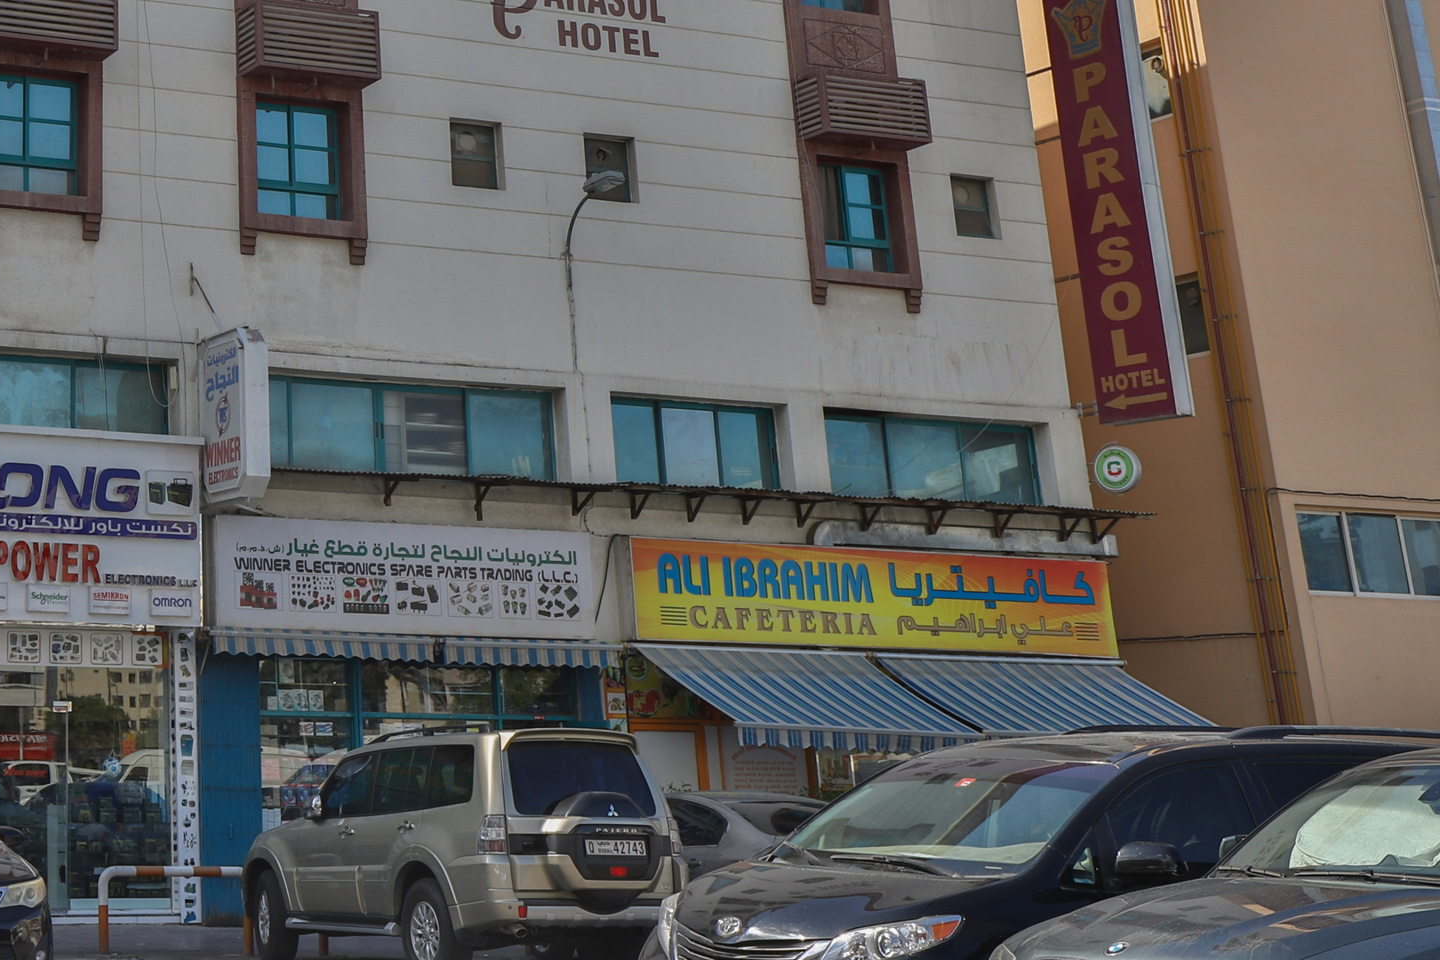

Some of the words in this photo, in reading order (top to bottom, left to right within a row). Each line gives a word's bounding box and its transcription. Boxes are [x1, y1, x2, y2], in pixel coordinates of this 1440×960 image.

[557, 20, 659, 58] HOTEL
[1072, 62, 1148, 368] PARASOL
[205, 365, 239, 402] النجاح
[1101, 368, 1166, 393] HOTEL
[206, 436, 240, 468] WINNER
[209, 466, 238, 485] ELECTRONICS
[88, 517, 122, 534] باور
[127, 520, 192, 536] نكست
[286, 538, 319, 556] غيار
[323, 539, 367, 560] قطع
[372, 541, 426, 560] لتجارة
[431, 544, 482, 563] النجاح
[486, 550, 577, 567] الكترونيات
[234, 557, 291, 572] WINNER
[295, 560, 386, 576] ELECTRONICS
[390, 563, 433, 578] SPARE
[437, 565, 477, 579] PARTS
[480, 567, 532, 582] TRADING
[657, 553, 711, 596] ALI
[722, 556, 874, 604] IBRAHIM
[105, 572, 177, 587] ELECTRONICS
[887, 561, 1095, 609] كافيتريا
[31, 592, 68, 605] Schneider
[93, 592, 129, 600] SEMIKRON
[153, 597, 191, 607] OMRON
[688, 604, 878, 636] CAFETERIA
[1011, 616, 1074, 646] علي
[613, 842, 644, 854] 42743
